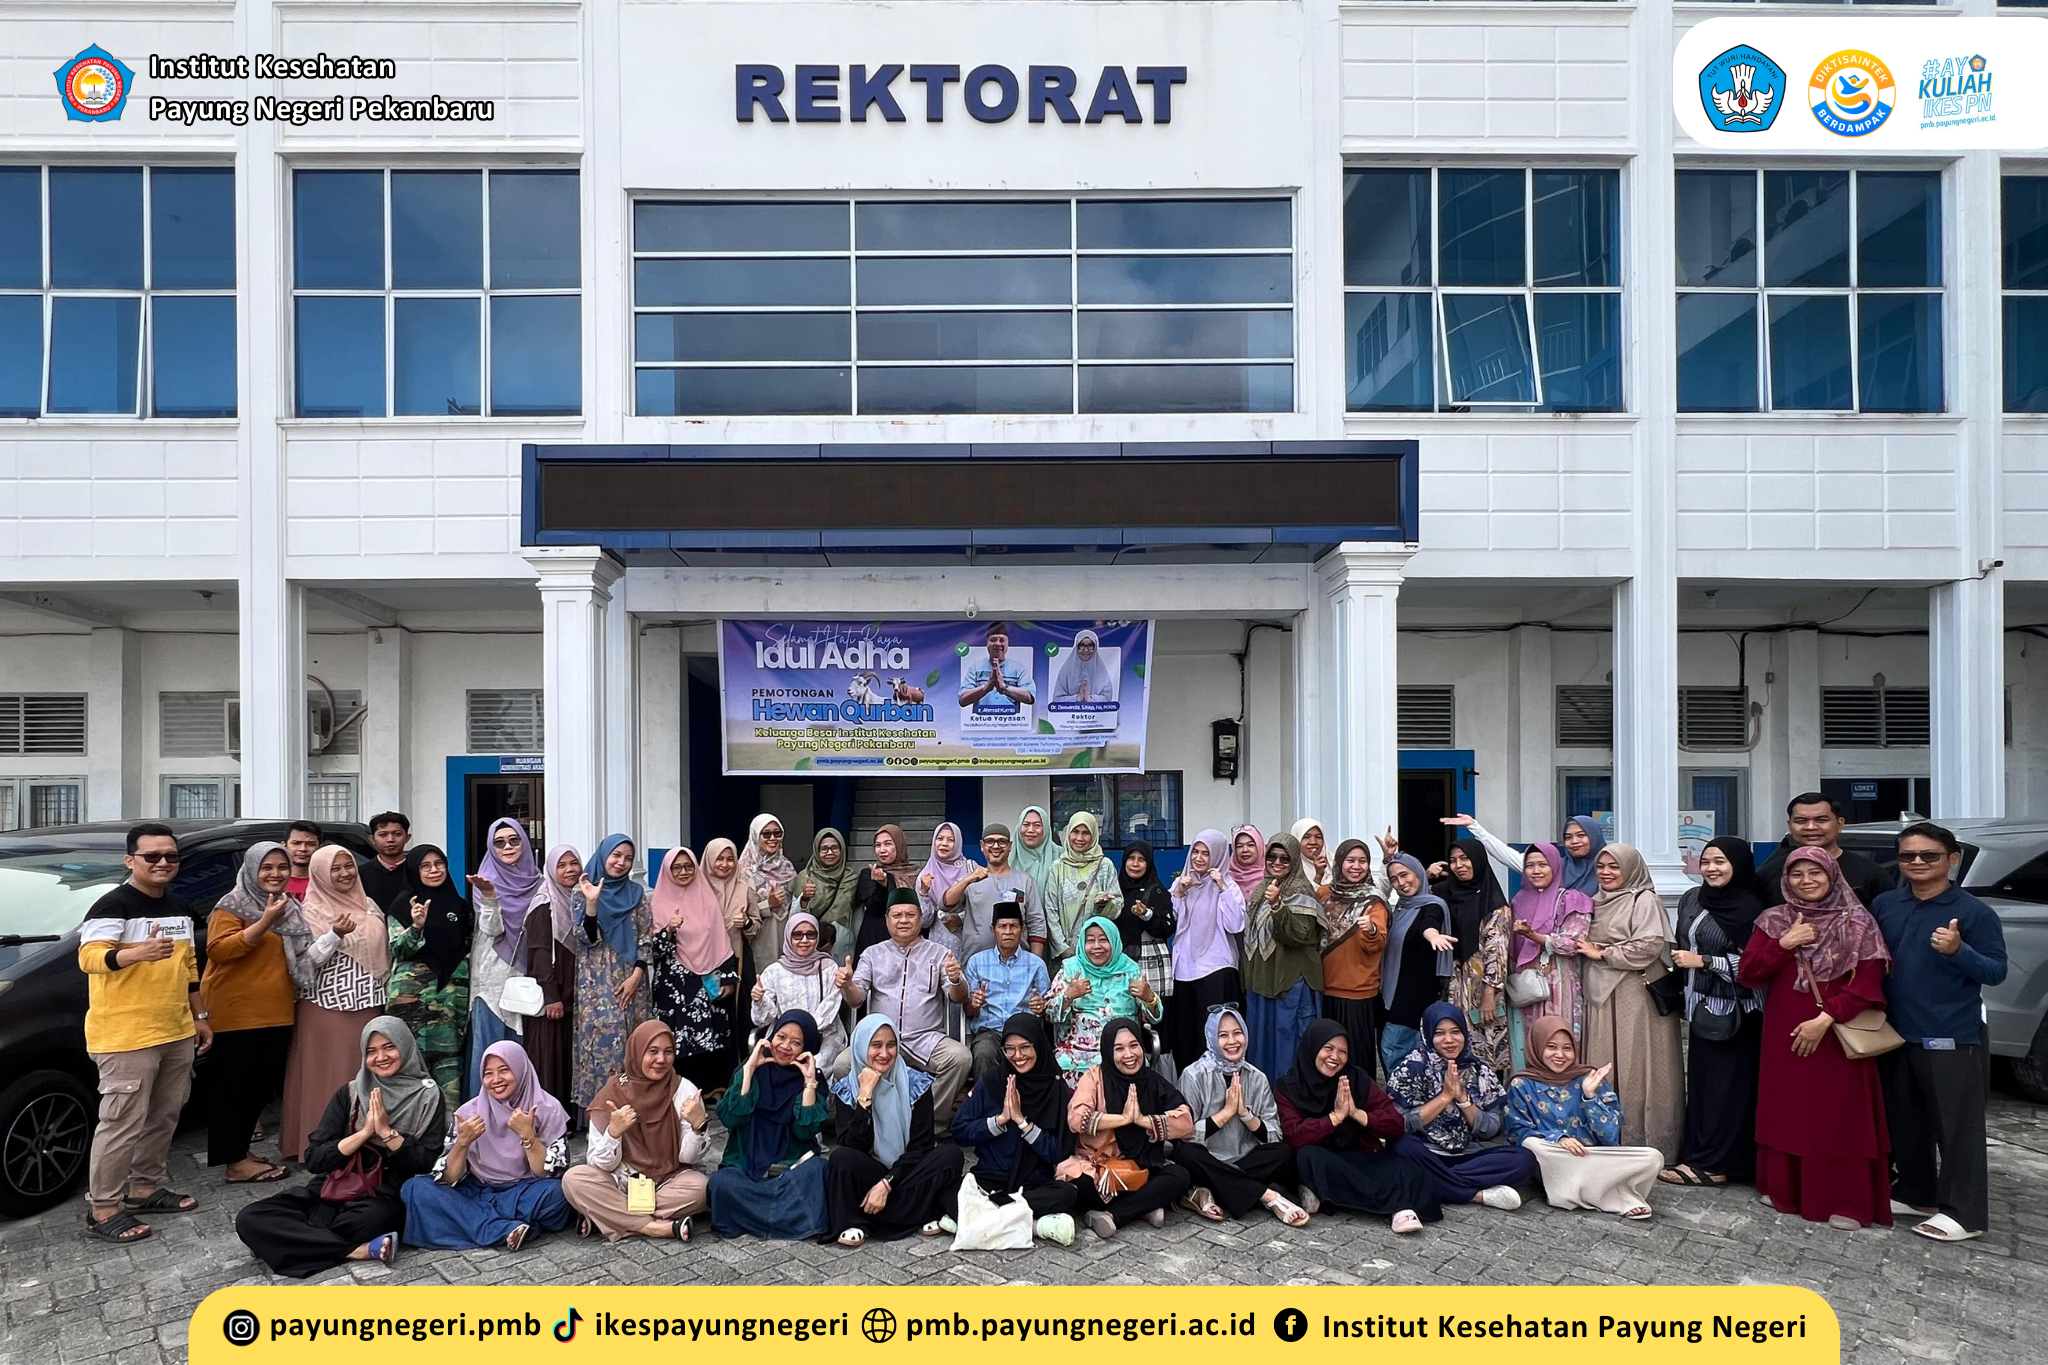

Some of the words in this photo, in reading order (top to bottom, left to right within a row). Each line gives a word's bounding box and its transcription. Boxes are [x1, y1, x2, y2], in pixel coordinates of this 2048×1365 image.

[735, 64, 1188, 125] REKTORAT
[755, 641, 815, 669] Idul
[819, 641, 910, 669] Adha
[752, 688, 834, 698] PEMOTONGAN
[752, 699, 840, 721] Hewan
[840, 699, 934, 725] Qurban
[993, 715, 1026, 723] Yayasan
[755, 727, 805, 740] Keluarga
[806, 727, 837, 738] Besar
[838, 727, 877, 738] Institut
[878, 727, 937, 738] Kesehatan
[777, 739, 818, 751] Payung
[820, 739, 855, 751] Negeri
[857, 739, 915, 749] Pekanbaru
